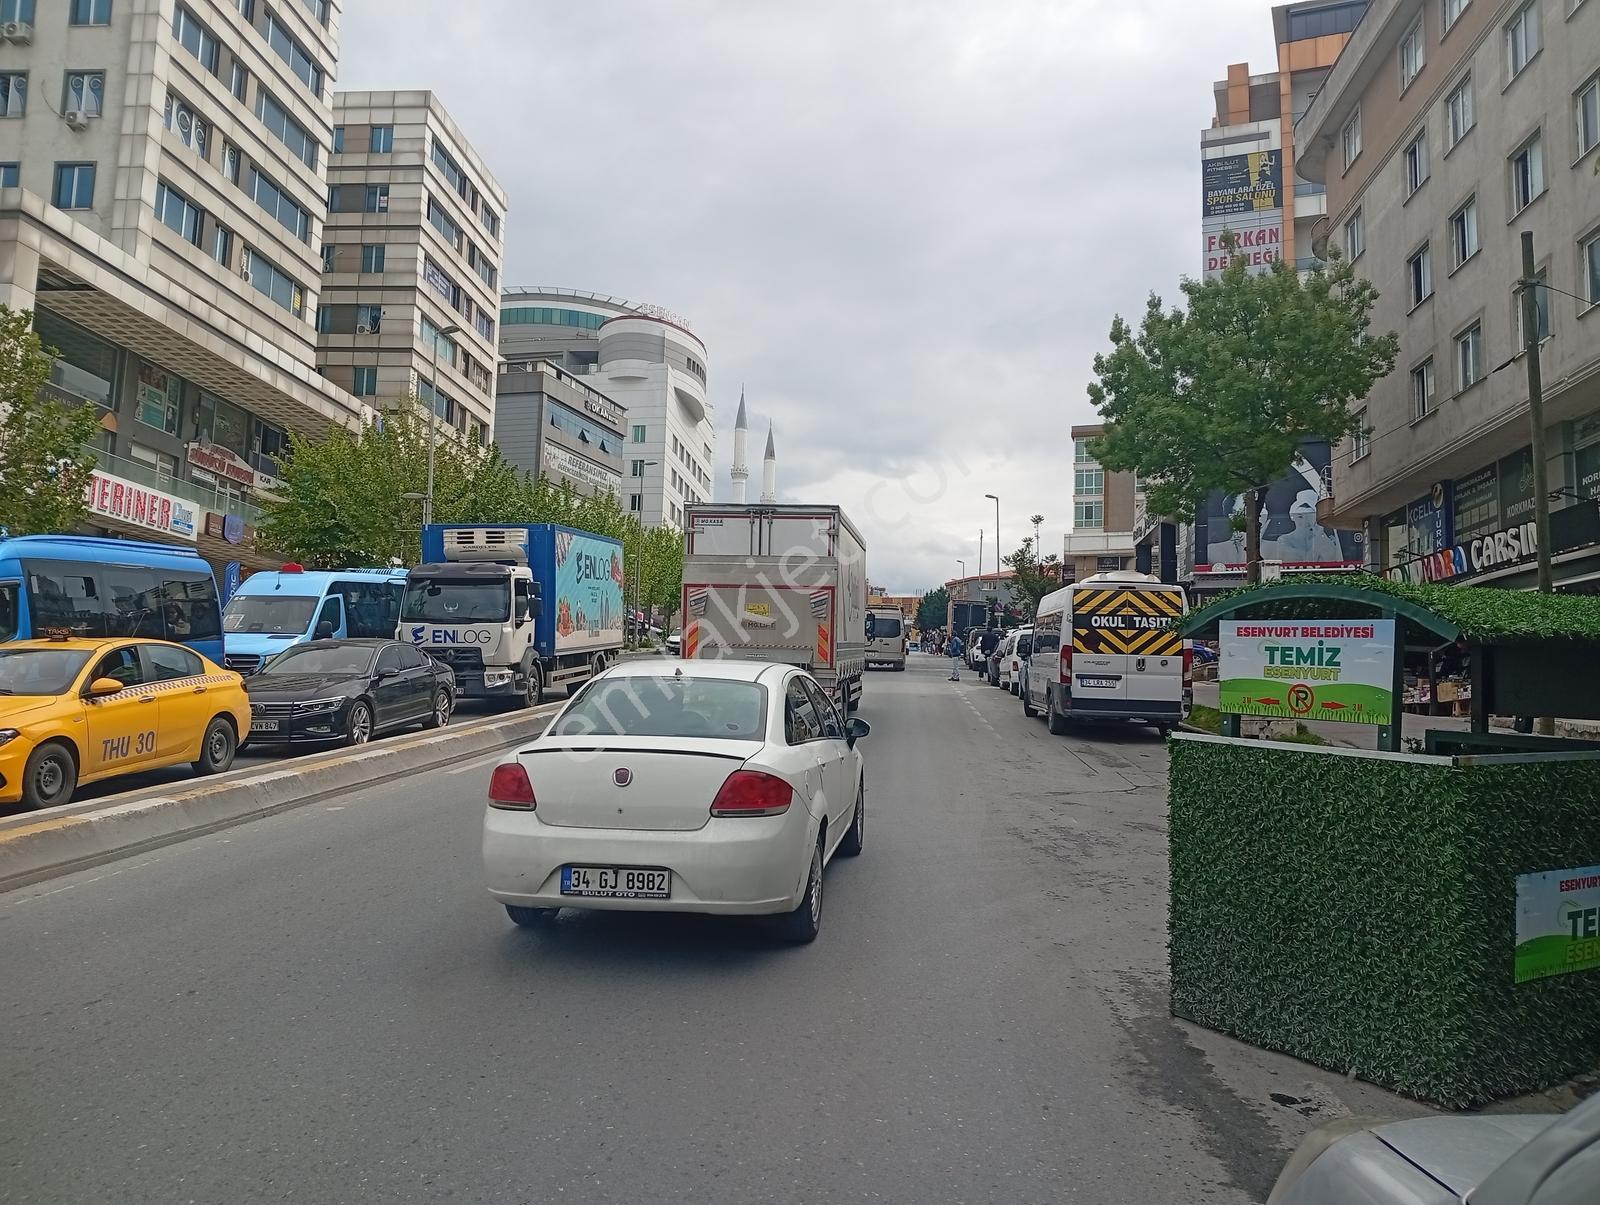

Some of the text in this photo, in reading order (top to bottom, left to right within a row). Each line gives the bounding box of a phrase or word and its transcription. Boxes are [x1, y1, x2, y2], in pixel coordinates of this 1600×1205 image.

[1207, 194, 1234, 206] SPOR
[1235, 188, 1276, 202] SALONU
[1208, 185, 1254, 198] BAYANLARA
[1582, 471, 1600, 486] KOR
[584, 554, 611, 582] ENLOG
[1091, 615, 1126, 627] OKUL
[432, 629, 492, 645] ENLOG
[1236, 624, 1374, 639] ESENYURT BELEDİYESİ
[1264, 640, 1341, 667] TEMİZ
[1263, 666, 1341, 681] ESENYURT
[264, 722, 277, 730] 847
[102, 730, 156, 763] THU 30
[572, 870, 590, 889] 34
[626, 872, 666, 891] 8982
[1567, 907, 1600, 941] TE
